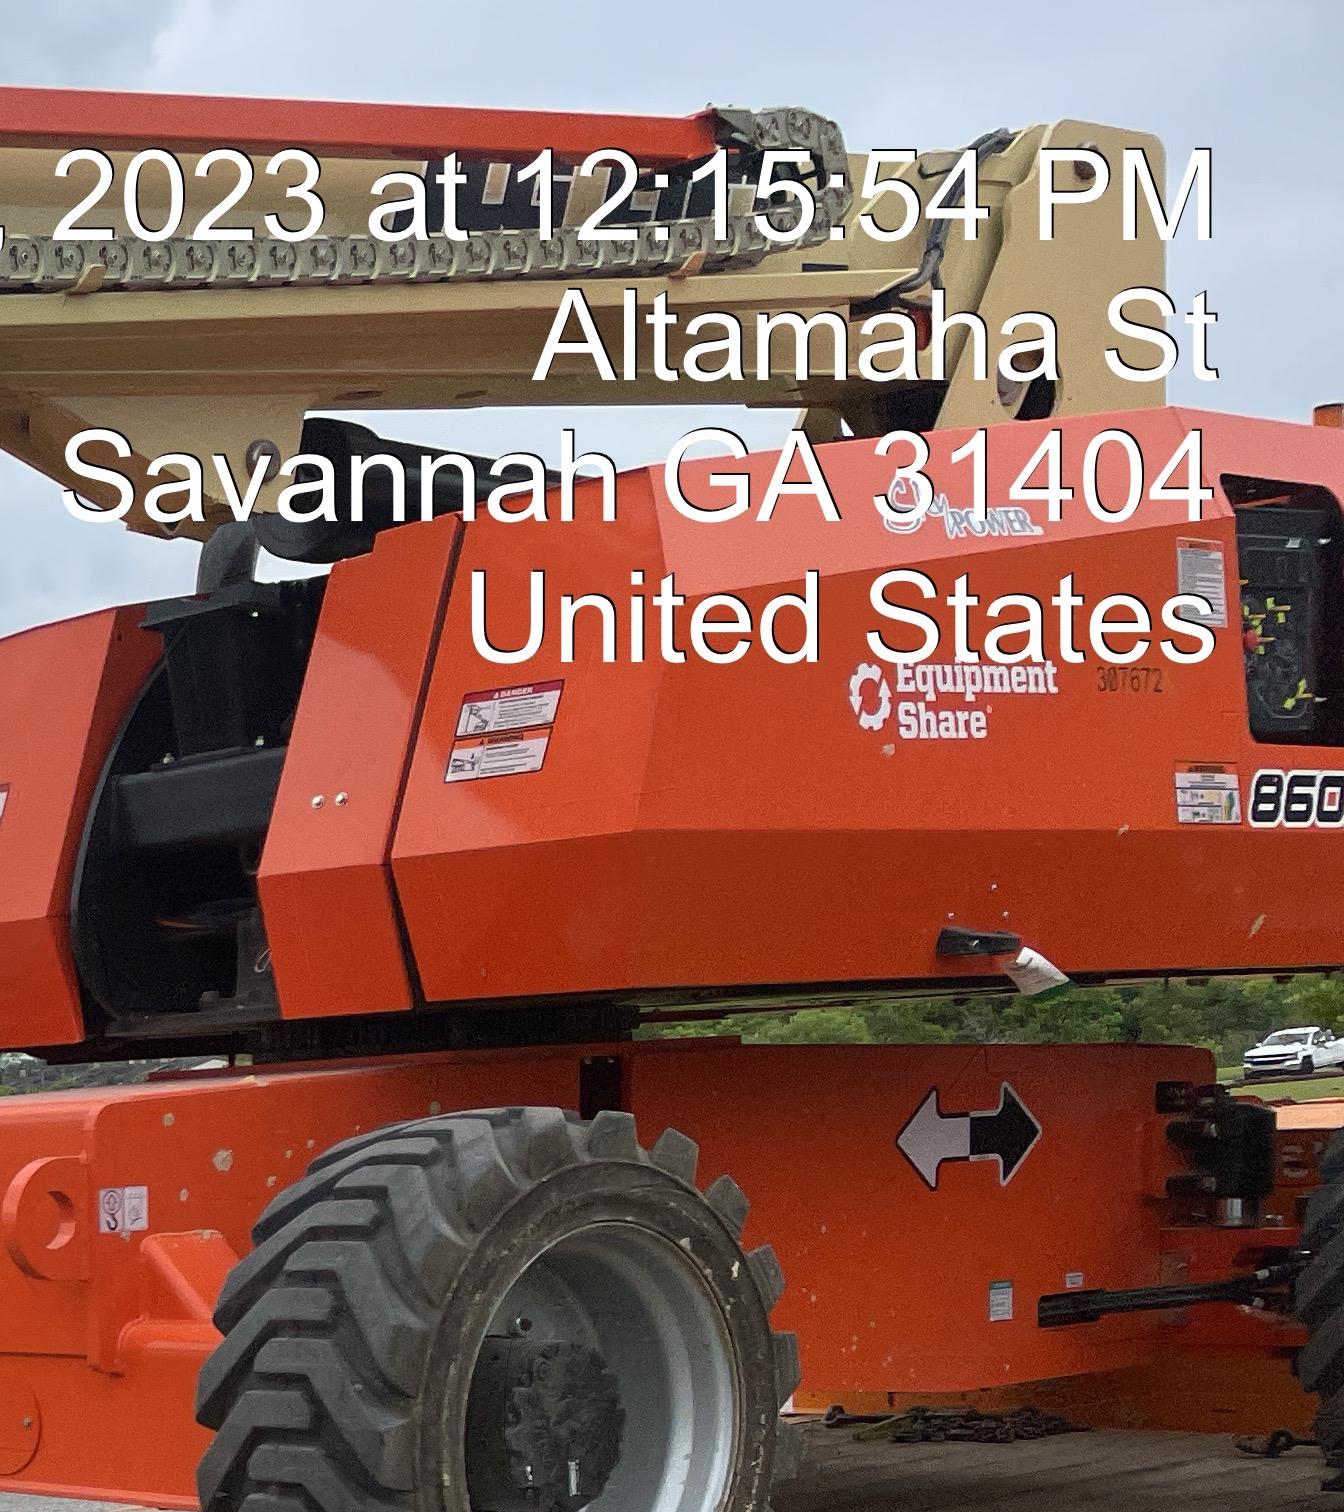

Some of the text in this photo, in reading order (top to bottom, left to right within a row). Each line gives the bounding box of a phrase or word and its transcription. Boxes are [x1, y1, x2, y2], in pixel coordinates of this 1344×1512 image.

[896, 659, 1058, 702] Equipment
[1097, 665, 1164, 693] 307672
[898, 700, 988, 739] Share
[1248, 769, 1344, 829] 860
